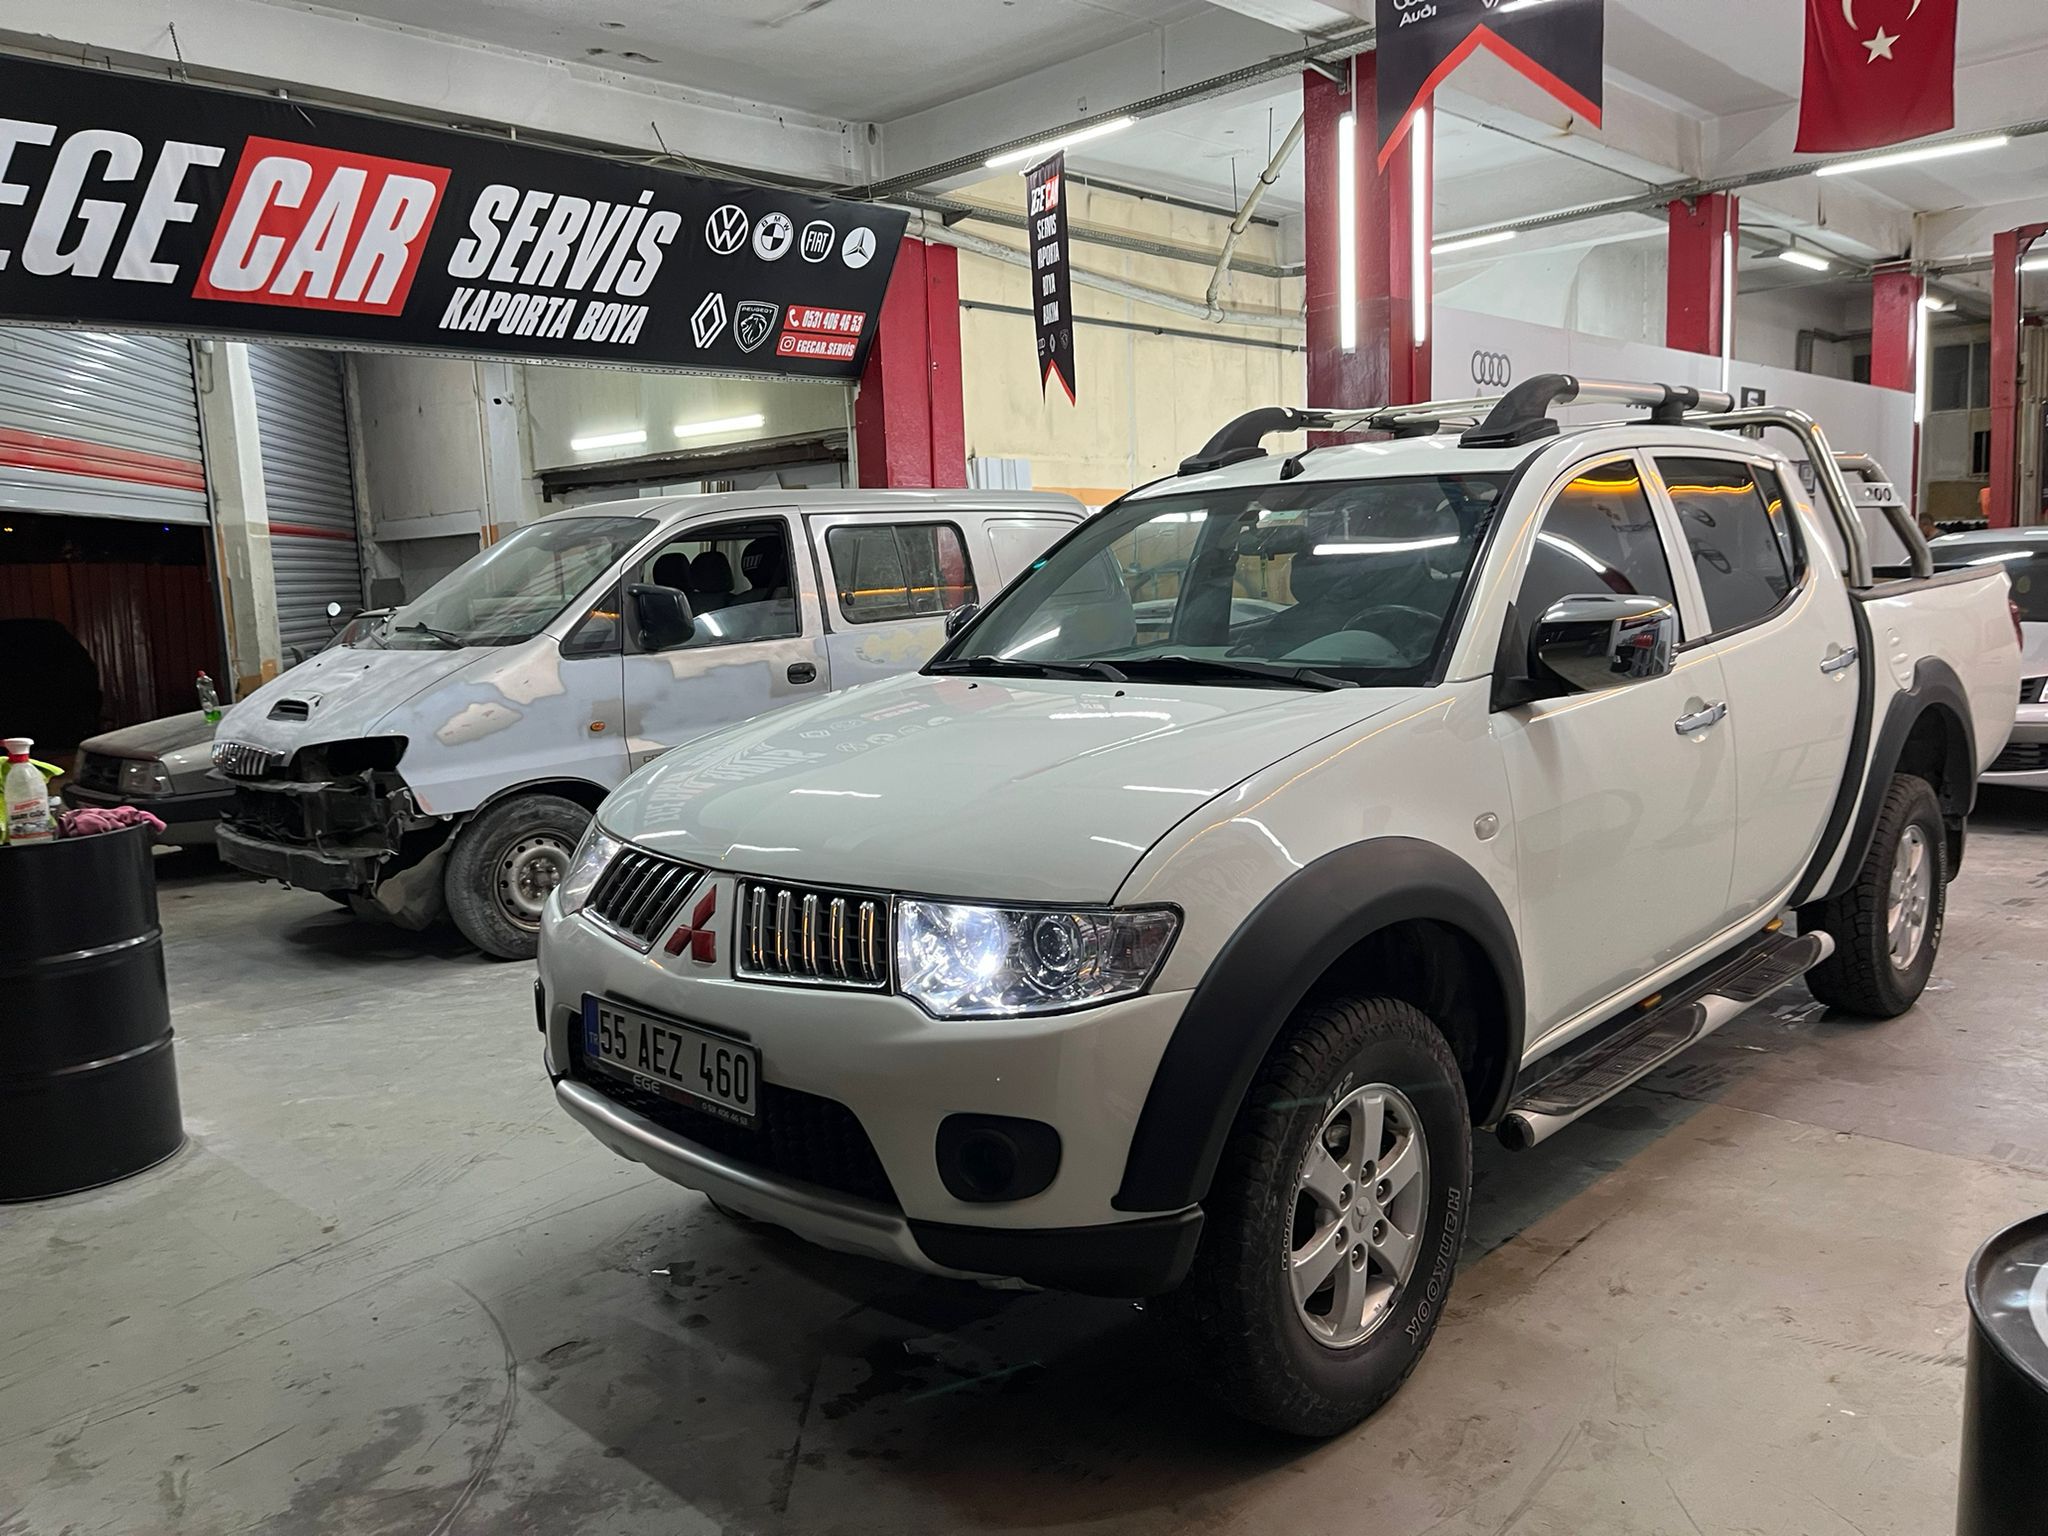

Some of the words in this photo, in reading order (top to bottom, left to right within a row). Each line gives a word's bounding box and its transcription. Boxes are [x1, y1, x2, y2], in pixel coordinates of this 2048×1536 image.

[209, 156, 437, 305] CAR
[447, 184, 682, 297] SERVİS
[806, 231, 829, 253] FIAT
[438, 286, 578, 339] KAPORTA
[572, 301, 650, 345] BOYA
[741, 306, 773, 314] PEUGEOT
[802, 310, 823, 329] 0531
[823, 312, 840, 331] 406
[839, 314, 852, 332] 46
[850, 315, 863, 333] 53
[600, 1010, 626, 1060] 55
[638, 1023, 683, 1082] AEZ
[700, 1043, 749, 1105] 460
[632, 1074, 660, 1095] EGE
